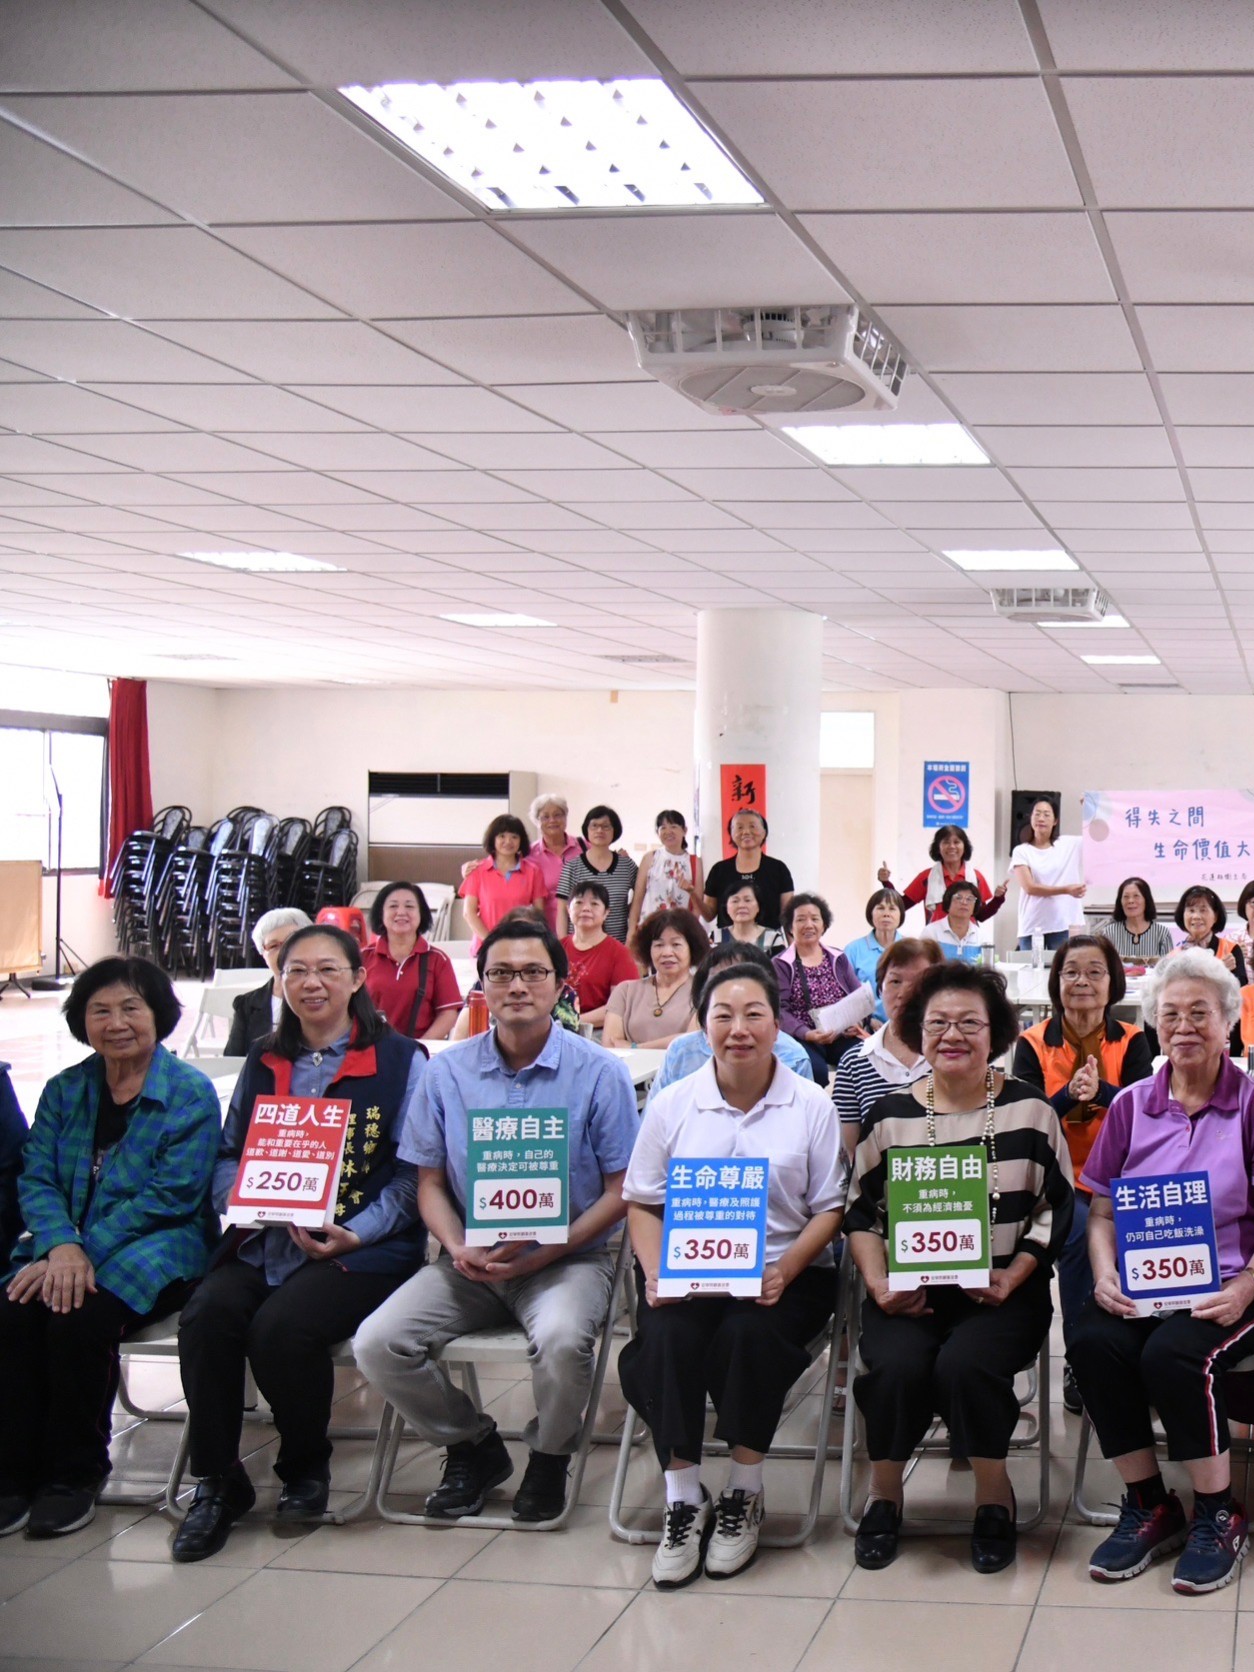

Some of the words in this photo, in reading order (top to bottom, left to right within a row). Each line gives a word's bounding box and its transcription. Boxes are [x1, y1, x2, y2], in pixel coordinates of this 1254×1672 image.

[1125, 806, 1205, 828] 得失之間
[254, 1103, 344, 1128] 四道人生
[472, 1115, 565, 1141] 醫療自主
[670, 1165, 764, 1190] 生命尊嚴
[891, 1154, 982, 1182] 財務自由
[1115, 1180, 1208, 1211] 生活自理
